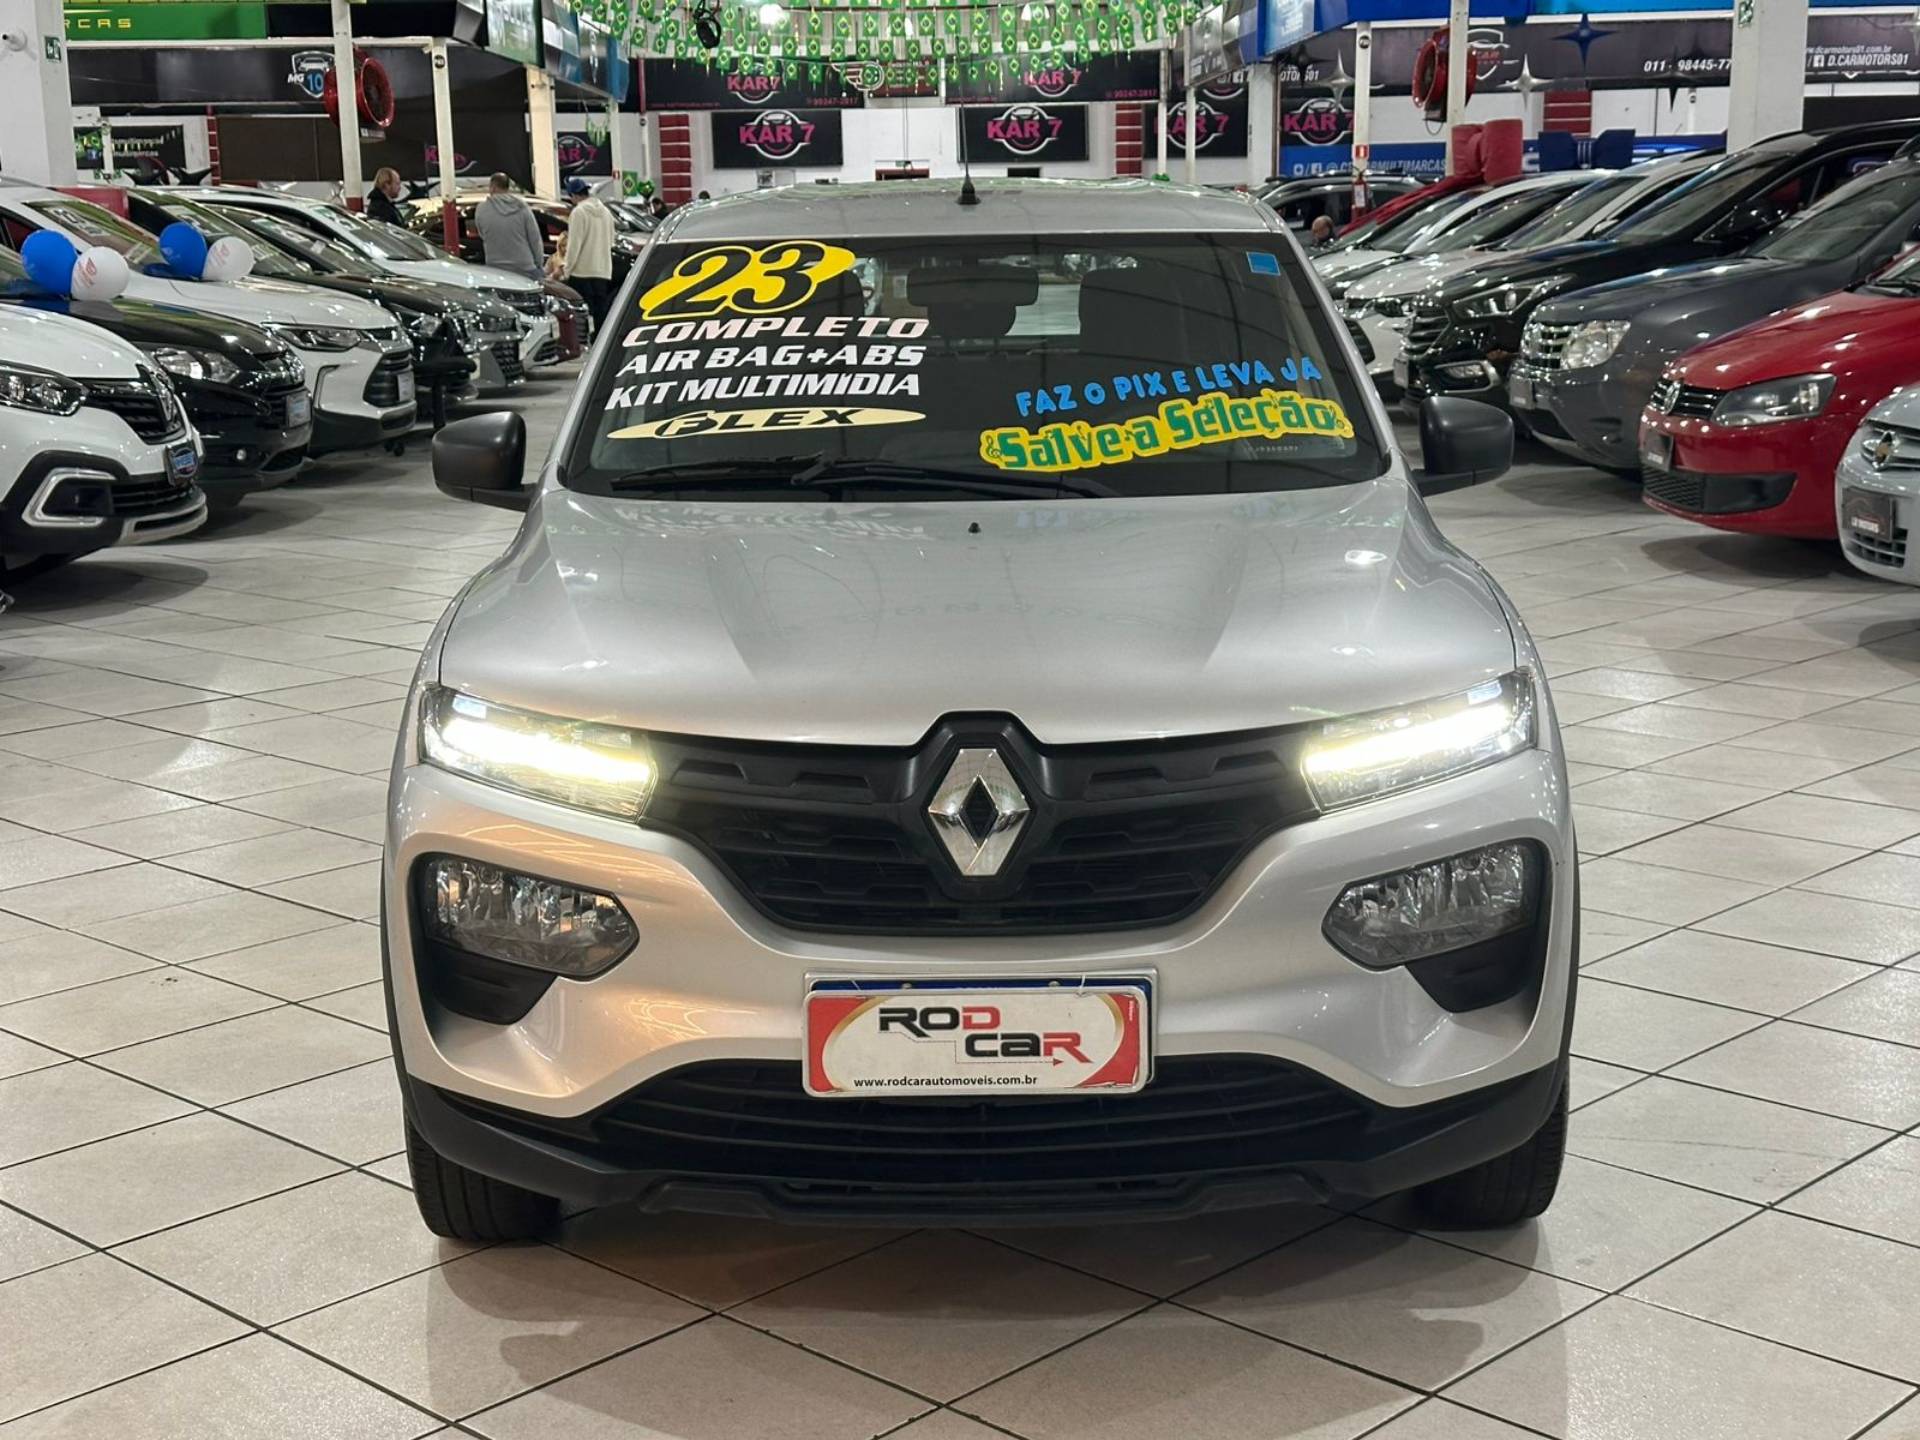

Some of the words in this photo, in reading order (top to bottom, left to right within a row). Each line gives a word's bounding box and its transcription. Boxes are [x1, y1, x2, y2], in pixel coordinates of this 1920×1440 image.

[1644, 60, 1666, 72] 011
[1677, 58, 1732, 71] 98445-77
[1827, 53, 1910, 67] D.CARMOTORS01
[307, 73, 324, 91] 10
[727, 75, 771, 91] KAR
[1023, 70, 1065, 86] KAR
[987, 119, 1041, 139] KAR
[1048, 119, 1063, 139] 7
[1215, 115, 1229, 134] 7
[1283, 112, 1338, 132] KAR
[739, 124, 794, 144] KAR
[800, 124, 816, 144] 7
[643, 241, 827, 319] 23
[622, 317, 930, 347] COMPLETO
[615, 350, 700, 378] AIR
[704, 345, 927, 369] BAG+ABS
[604, 382, 678, 411] KIT
[1015, 384, 1077, 417] FAZ
[1084, 383, 1106, 405] O
[1112, 373, 1167, 401] PIX
[1170, 369, 1192, 394] E
[1193, 360, 1275, 391] LEVA
[1279, 356, 1323, 384] JA
[654, 409, 864, 438] FLEX
[997, 427, 1125, 469] Salve
[1131, 420, 1160, 452] a
[1164, 393, 1337, 442] Seleção
[879, 1005, 1001, 1038] ROD
[854, 1074, 1038, 1089] www.rodcarautomoveis.com.br
